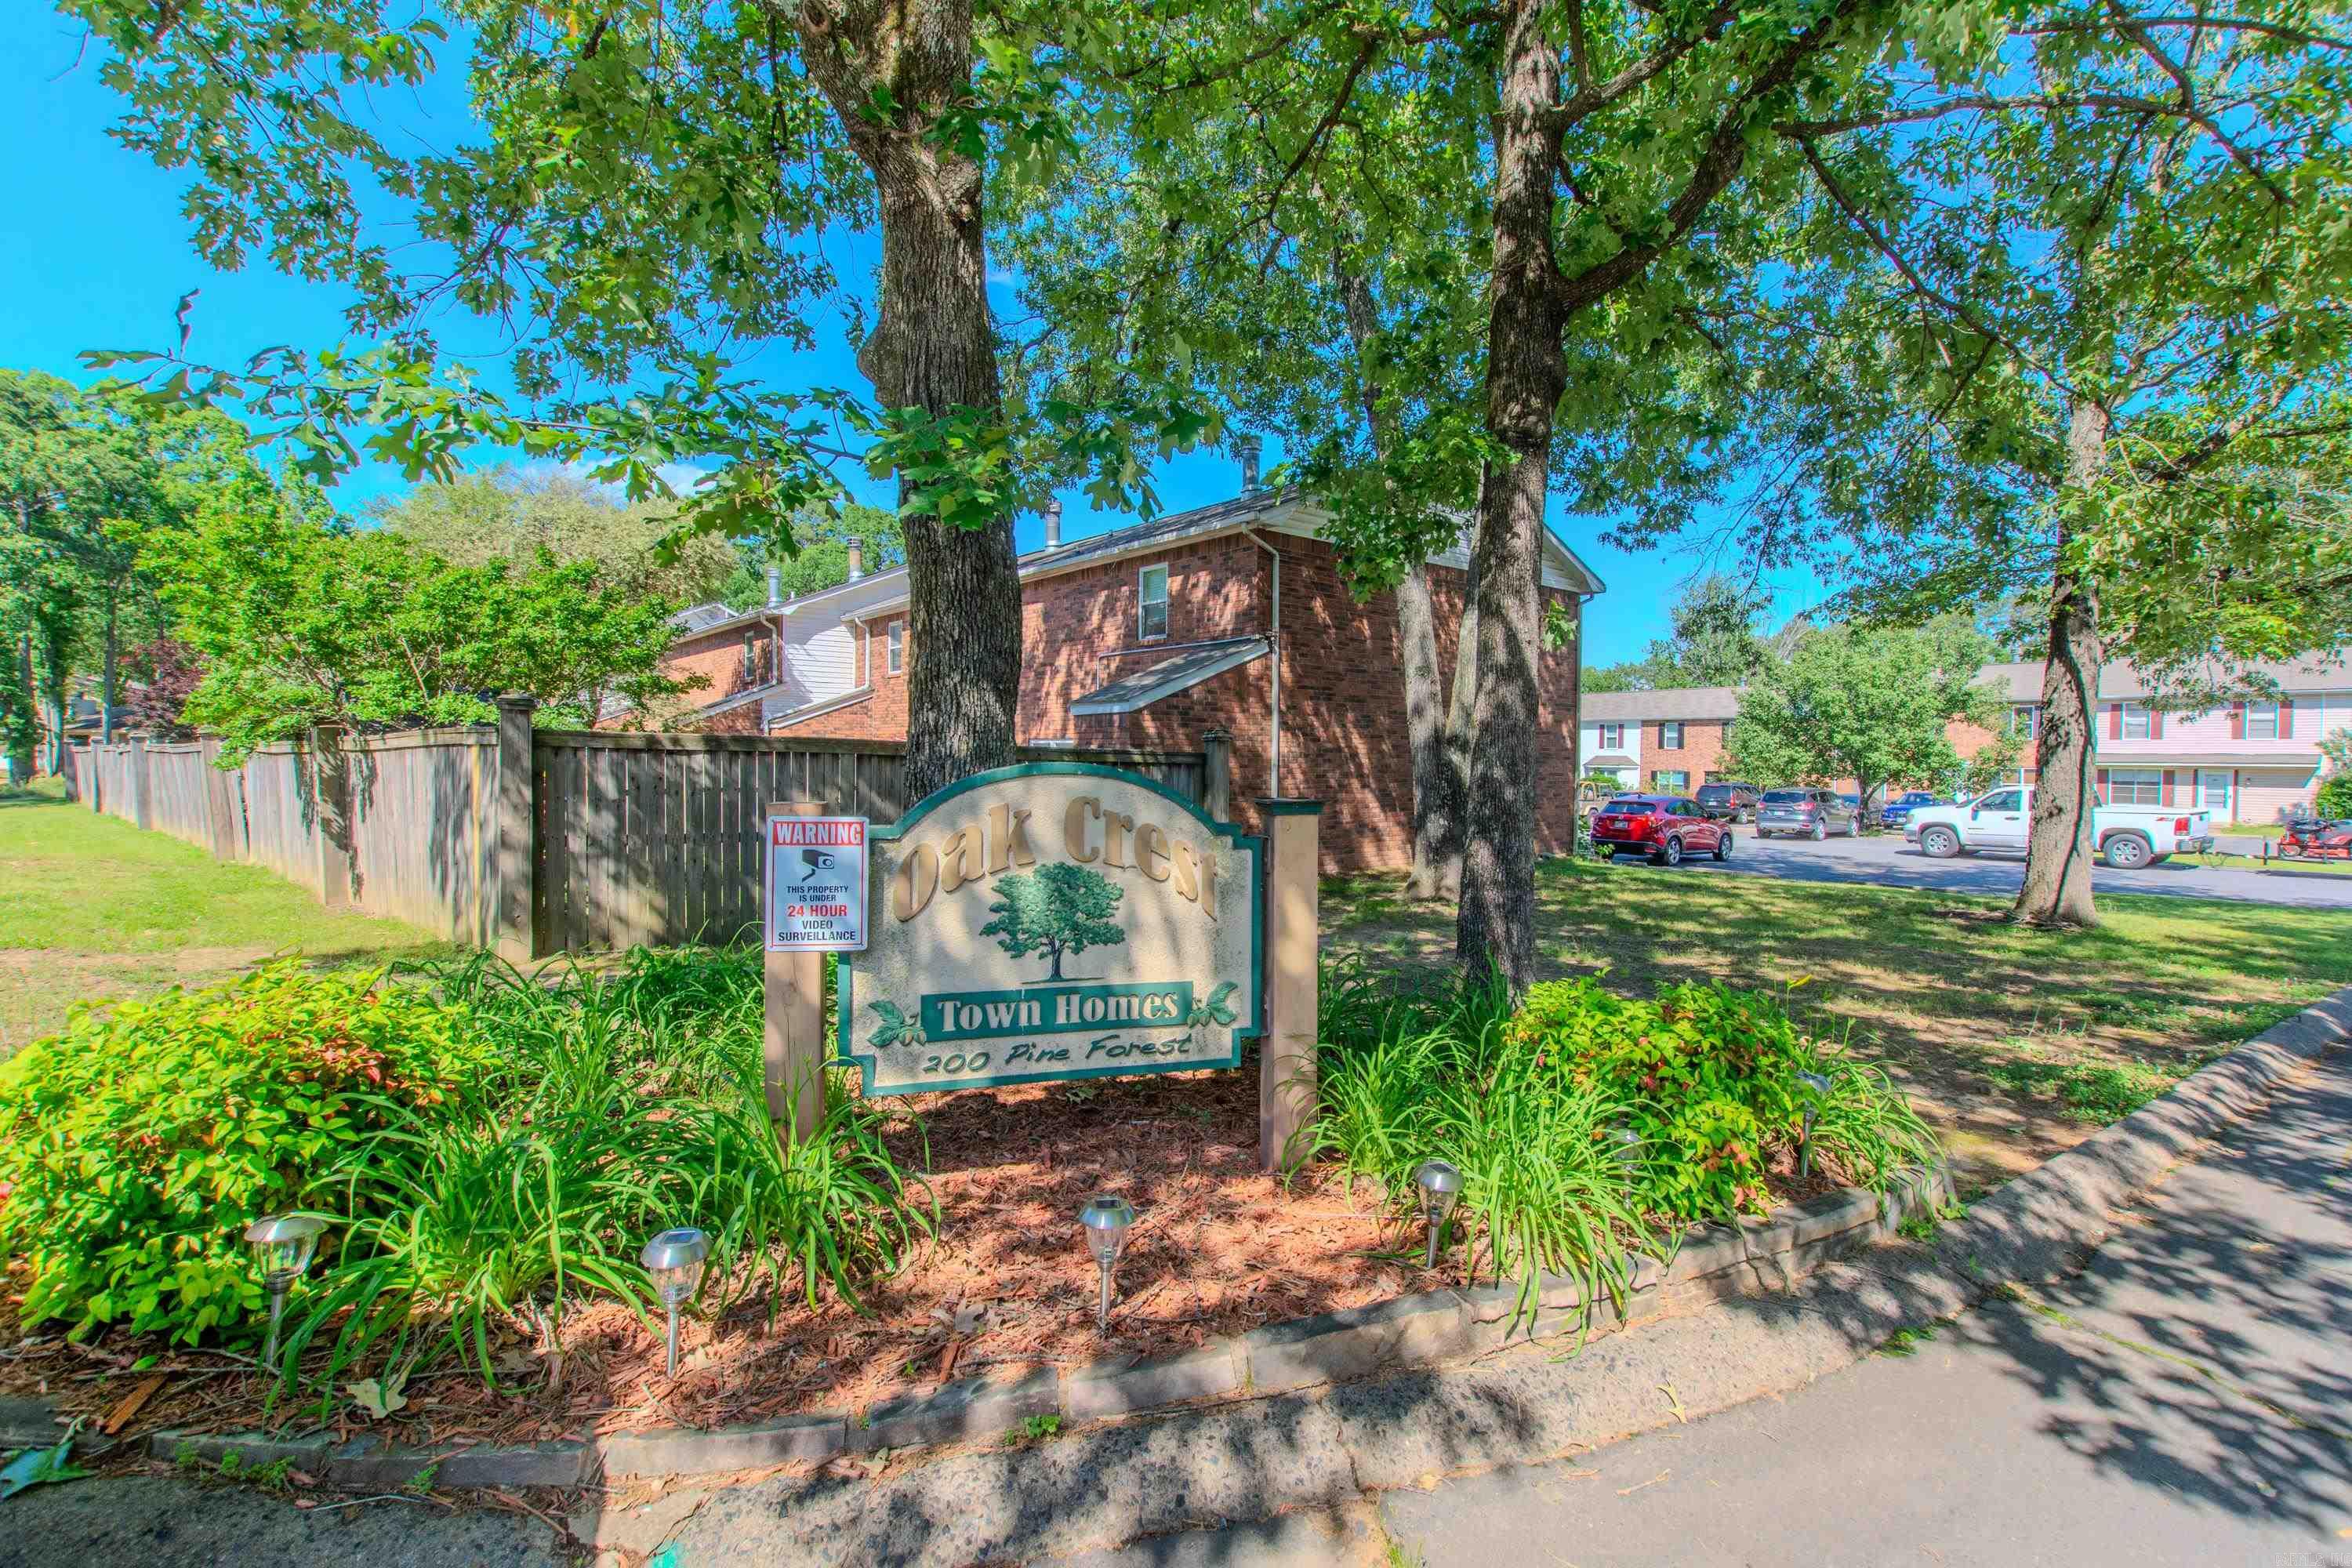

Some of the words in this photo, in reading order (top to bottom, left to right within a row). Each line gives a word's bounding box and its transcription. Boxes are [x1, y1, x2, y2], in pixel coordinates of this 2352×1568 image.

[775, 823, 862, 844] WARNING
[892, 802, 1036, 923] Oak
[1064, 796, 1218, 922] Crest
[808, 885, 848, 894] PROPERTY
[787, 905, 804, 917] 24
[810, 905, 848, 916] HOUR
[802, 920, 833, 930] VIDEO
[779, 931, 856, 942] SURVEILLANCE
[938, 999, 1042, 1033] Town
[1054, 992, 1180, 1025] Homes
[923, 1052, 990, 1074] 200
[1004, 1041, 1071, 1065] Pine
[1085, 1033, 1192, 1060] Forest
